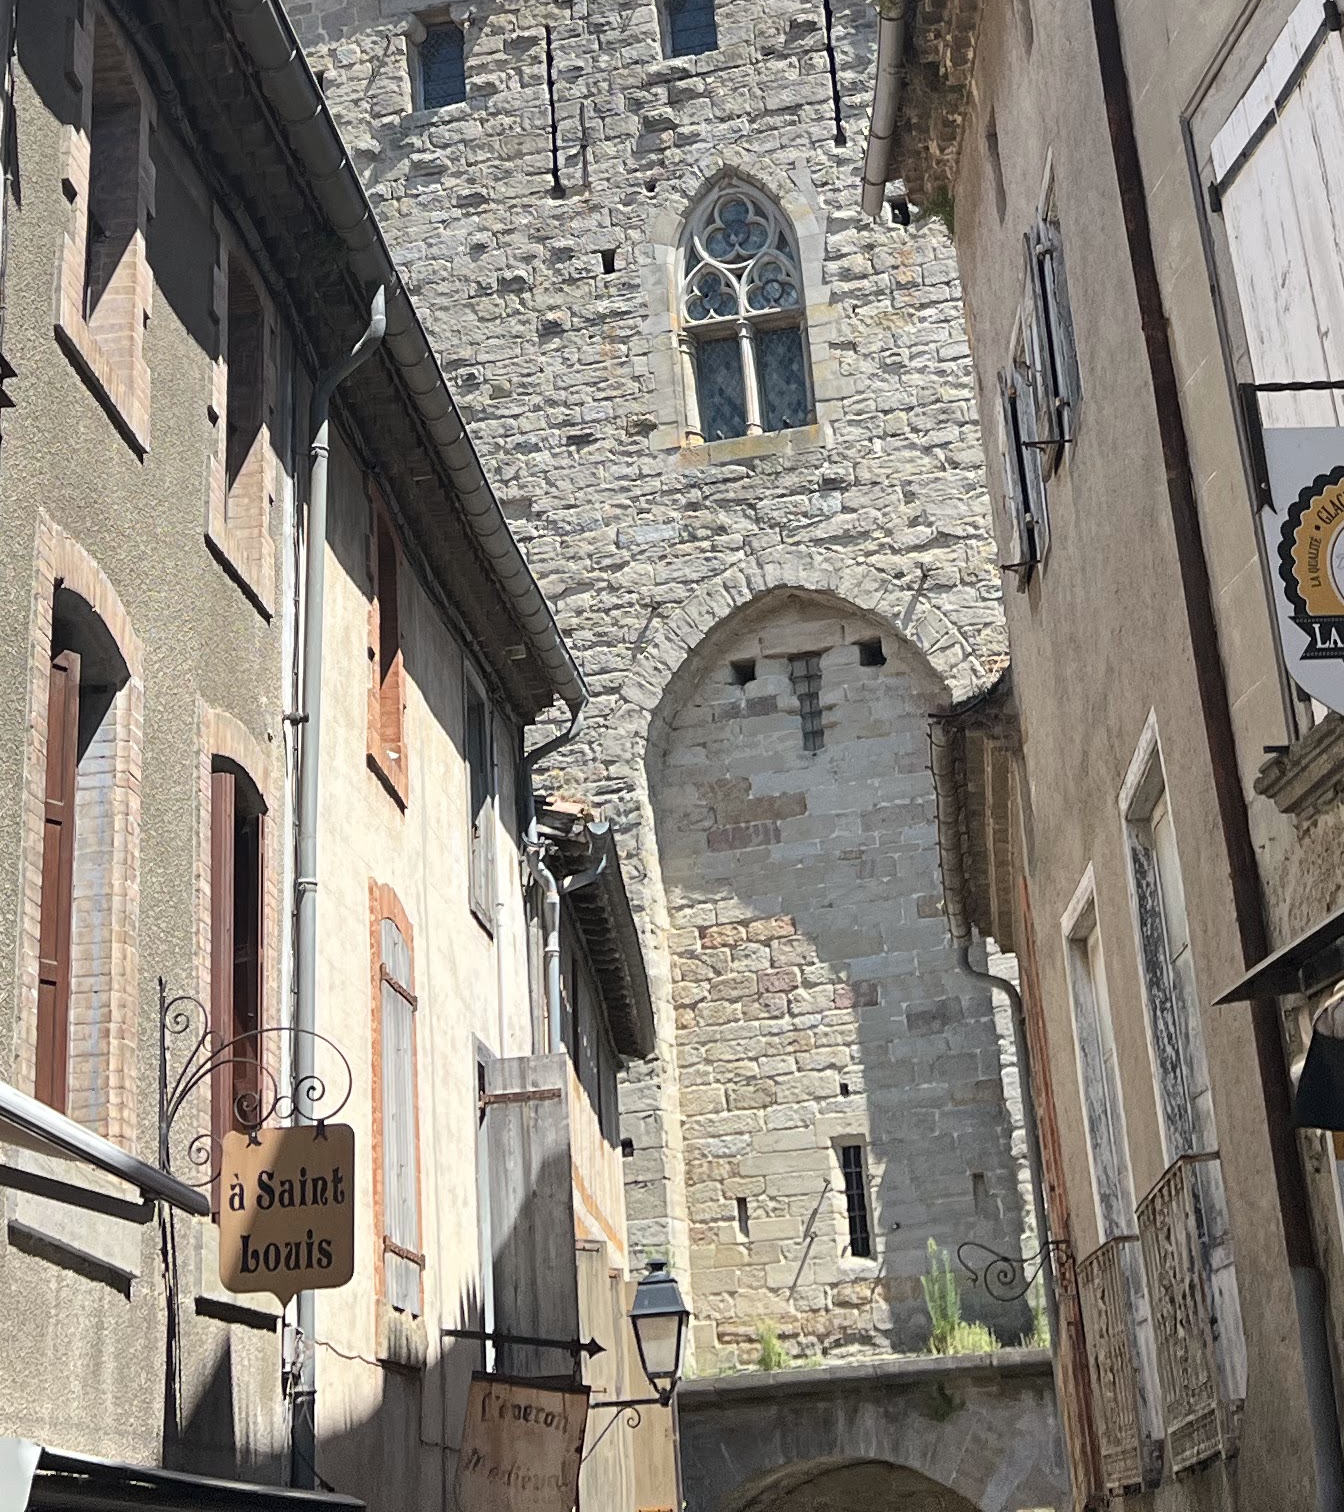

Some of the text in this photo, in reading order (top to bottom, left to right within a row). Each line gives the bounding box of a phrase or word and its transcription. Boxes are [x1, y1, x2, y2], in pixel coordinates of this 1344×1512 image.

[1310, 575, 1322, 588] LA
[1312, 622, 1344, 649] LA
[228, 1167, 345, 1211] à Saint
[240, 1229, 333, 1274] Louis
